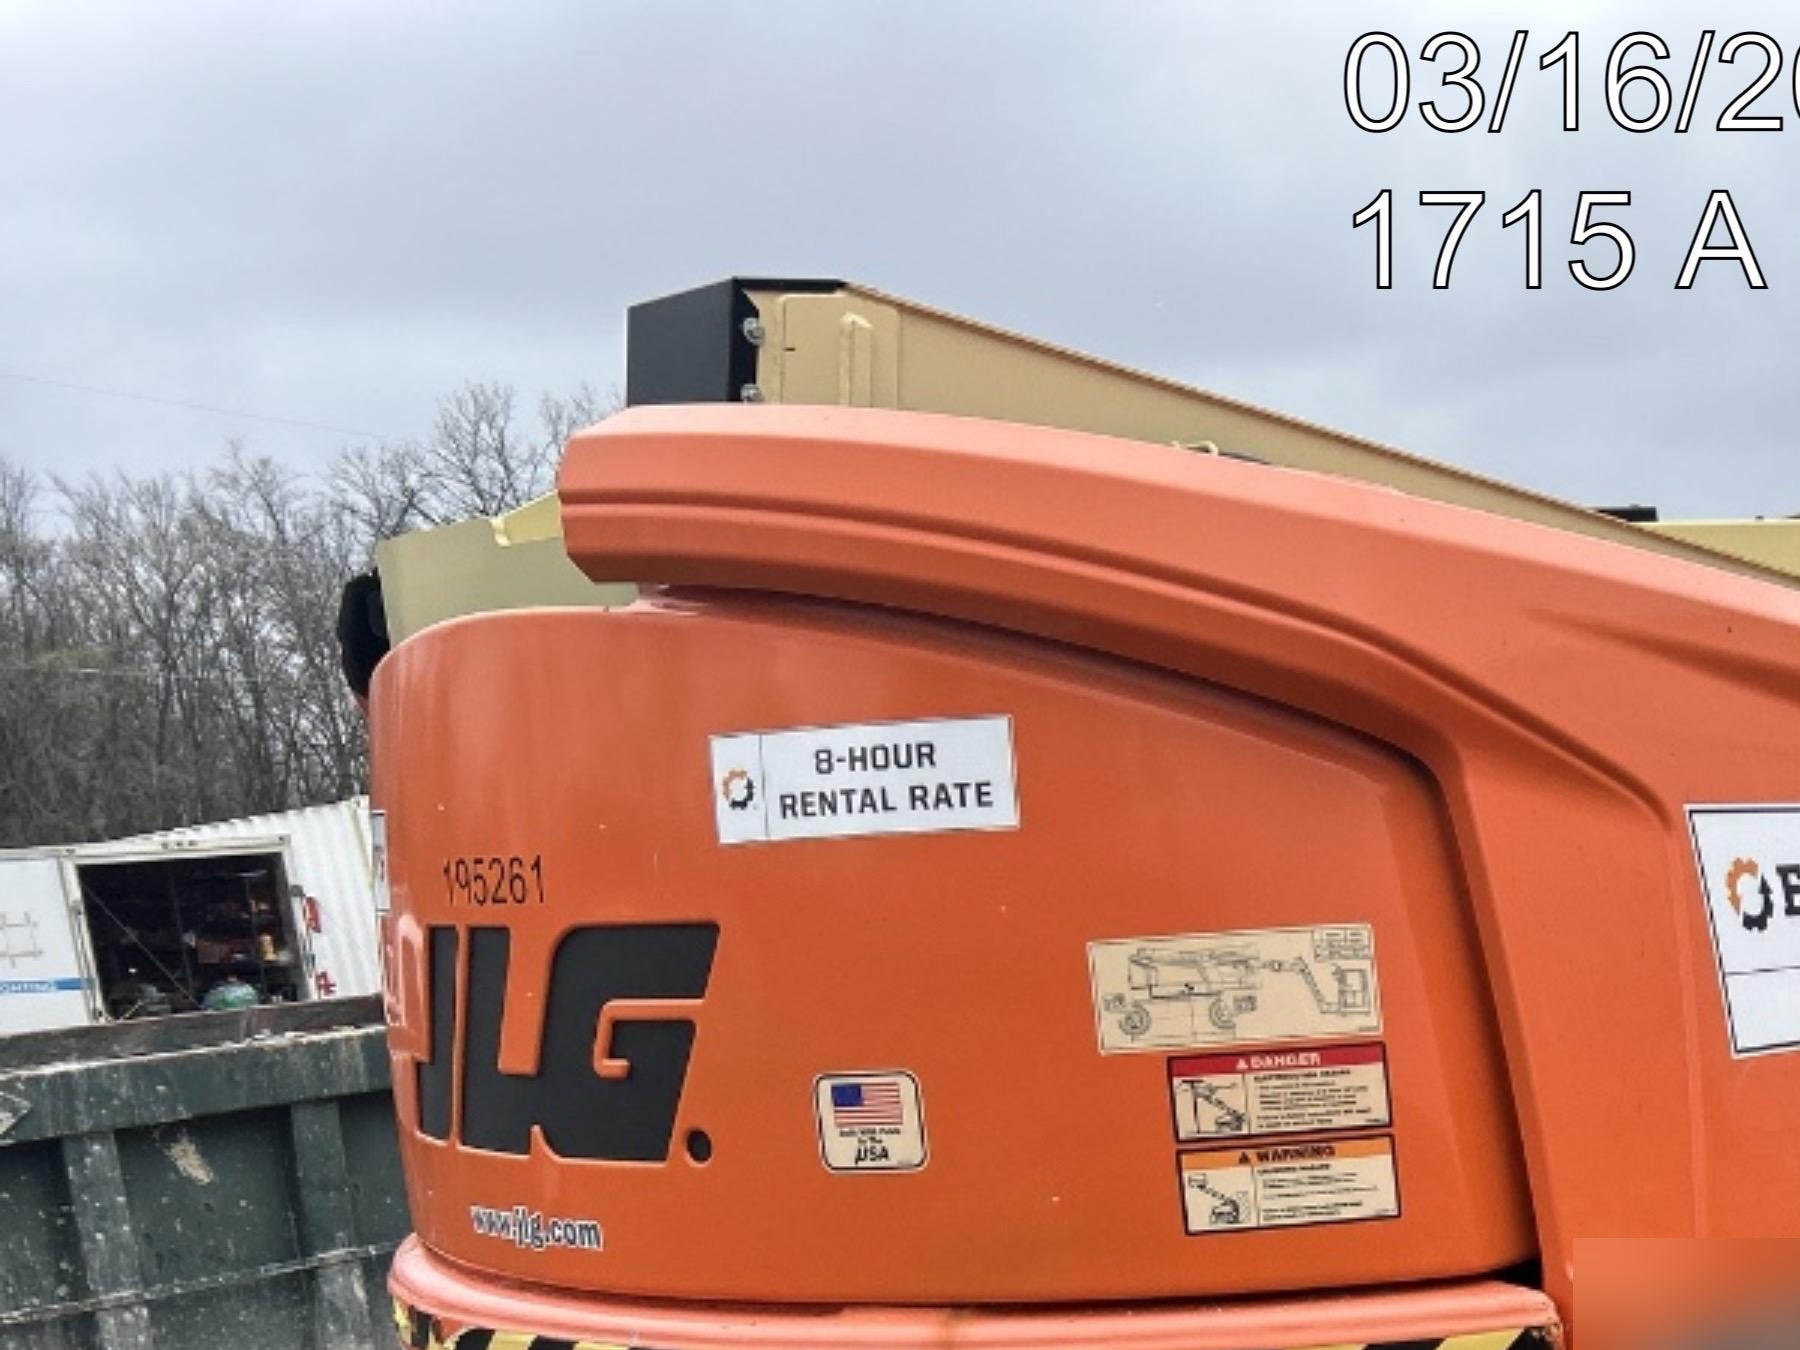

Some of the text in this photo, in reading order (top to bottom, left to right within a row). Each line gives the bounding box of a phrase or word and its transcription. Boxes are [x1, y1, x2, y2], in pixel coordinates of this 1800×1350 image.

[813, 741, 937, 775] 8-HOUR
[779, 780, 994, 820] RENTAL RATE
[442, 854, 546, 906] 195261
[1250, 1053, 1321, 1070] DANGER
[1256, 1145, 1336, 1164] WARNING
[468, 1203, 604, 1252] www.jlg.com
